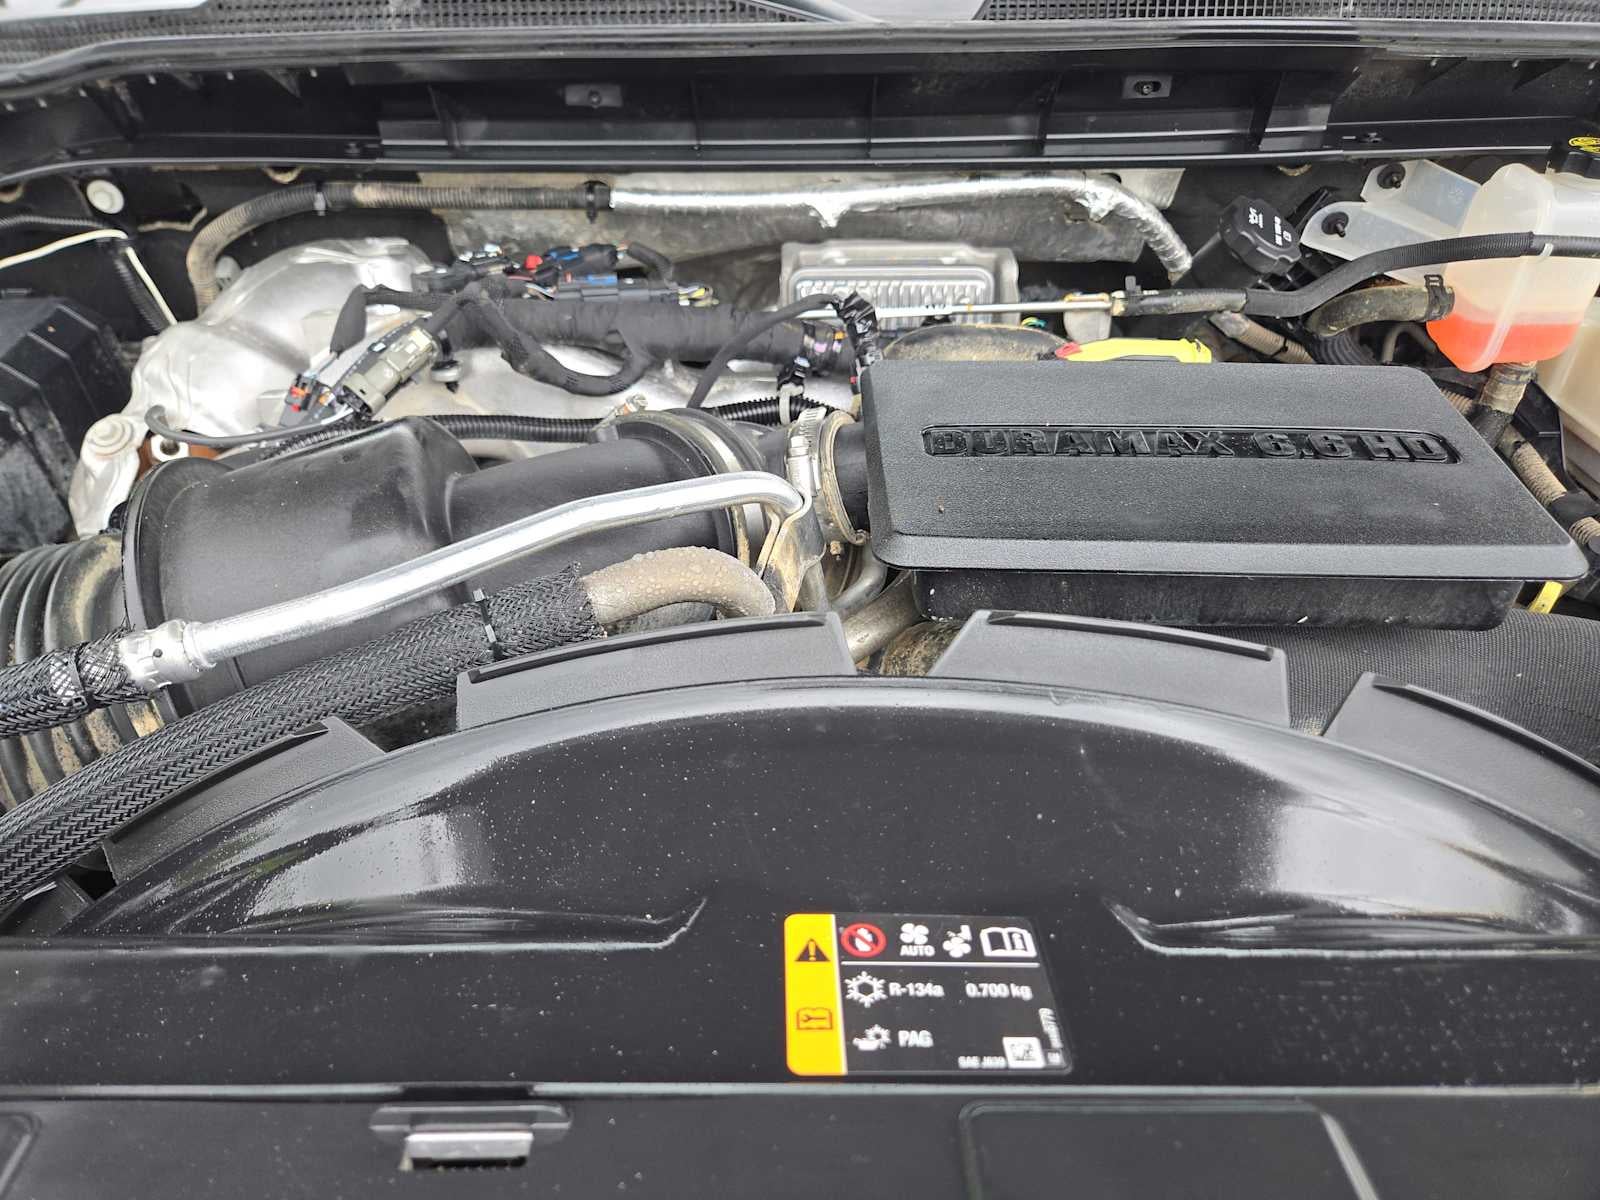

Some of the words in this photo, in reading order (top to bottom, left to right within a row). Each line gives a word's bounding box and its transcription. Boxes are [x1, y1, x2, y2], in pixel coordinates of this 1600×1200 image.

[930, 430, 1235, 457] DURAMAX
[1252, 432, 1353, 459] 6.6
[1358, 433, 1449, 462] HD
[900, 945, 935, 957] AUTO
[888, 982, 945, 998] R-134a
[965, 983, 1010, 998] 0.700
[1011, 983, 1034, 1001] kg
[898, 1030, 934, 1048] PAG
